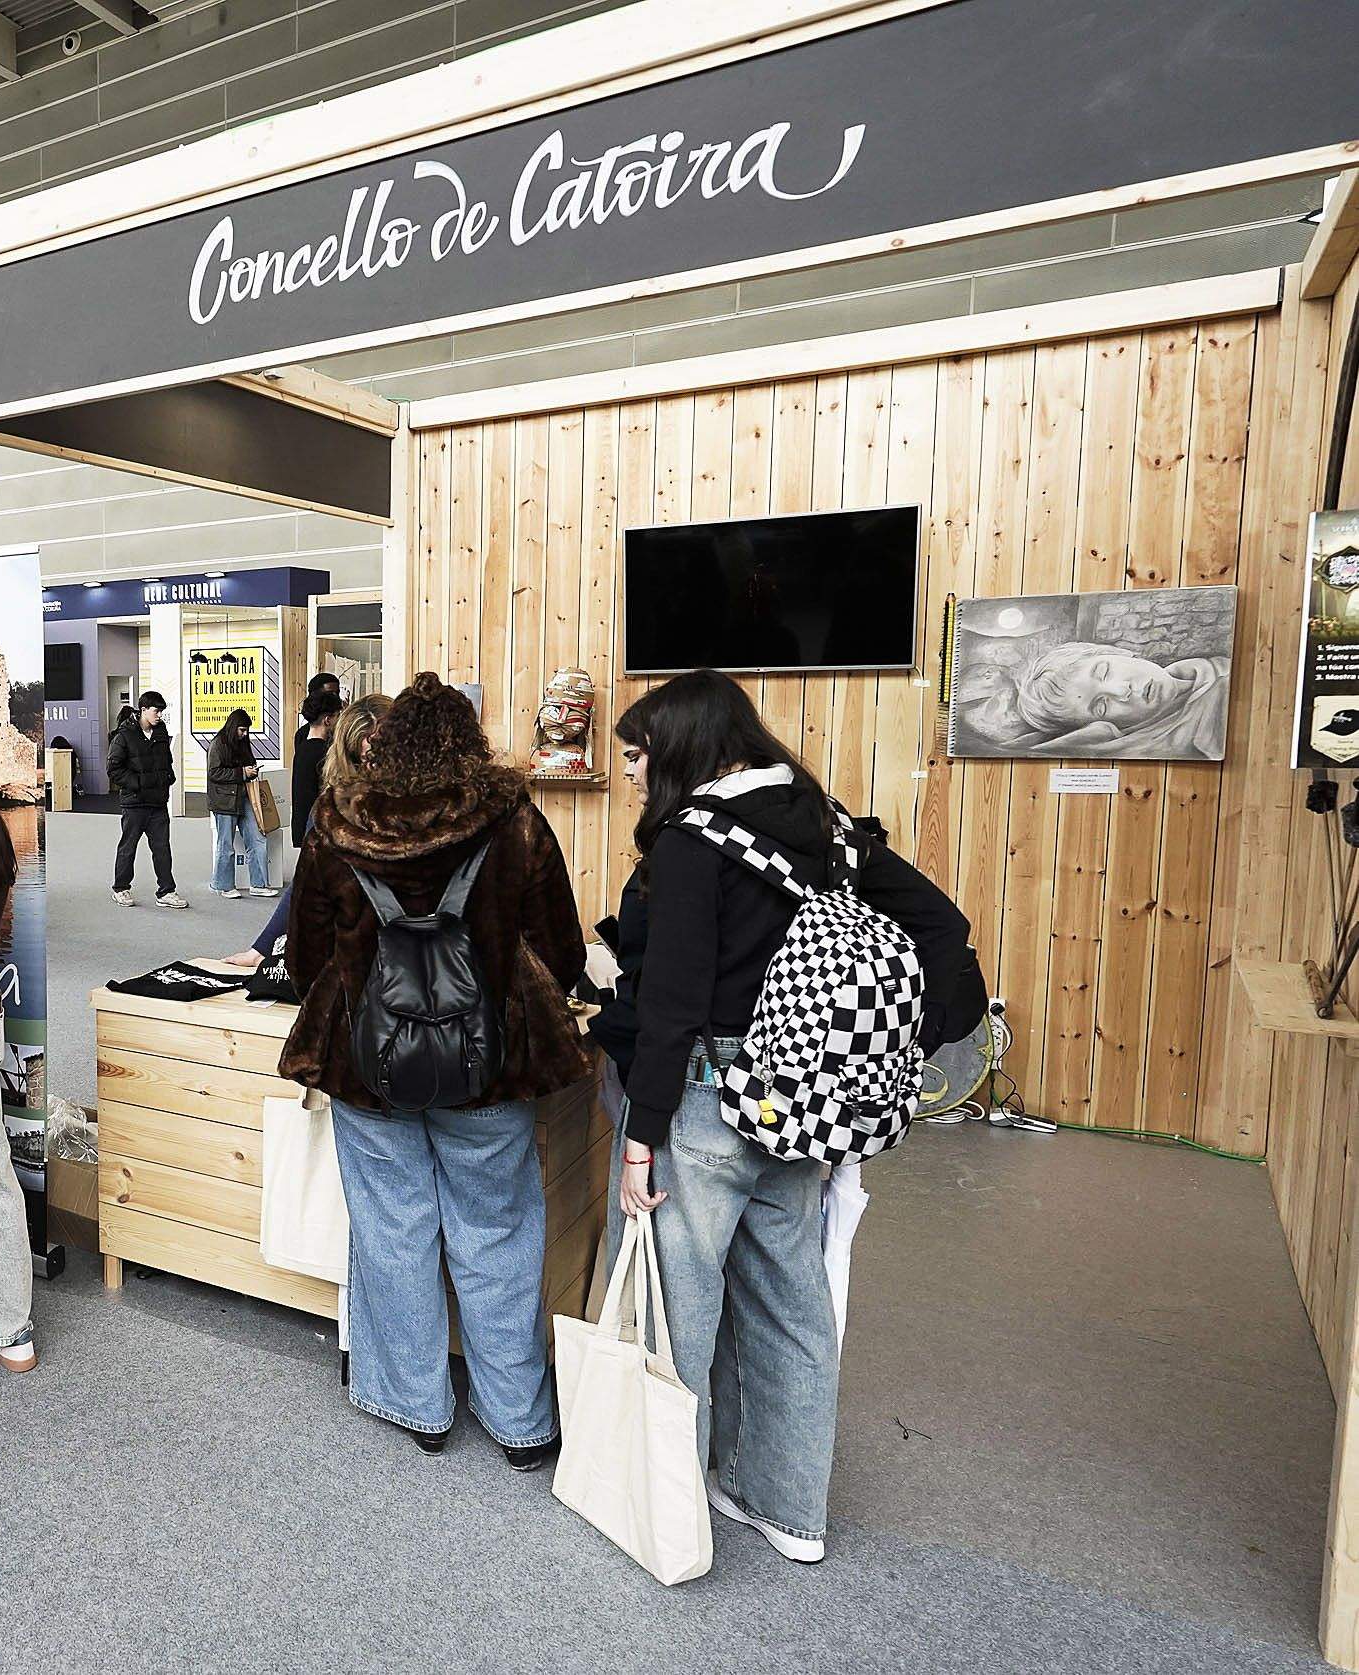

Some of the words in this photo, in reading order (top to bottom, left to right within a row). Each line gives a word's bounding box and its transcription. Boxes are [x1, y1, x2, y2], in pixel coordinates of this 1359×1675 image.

[189, 179, 419, 325] Concello
[415, 160, 499, 262] de
[509, 122, 867, 247] Catoira
[171, 581, 222, 600] CULTURAL
[203, 681, 214, 695] UN
[218, 679, 255, 695] DEREITO
